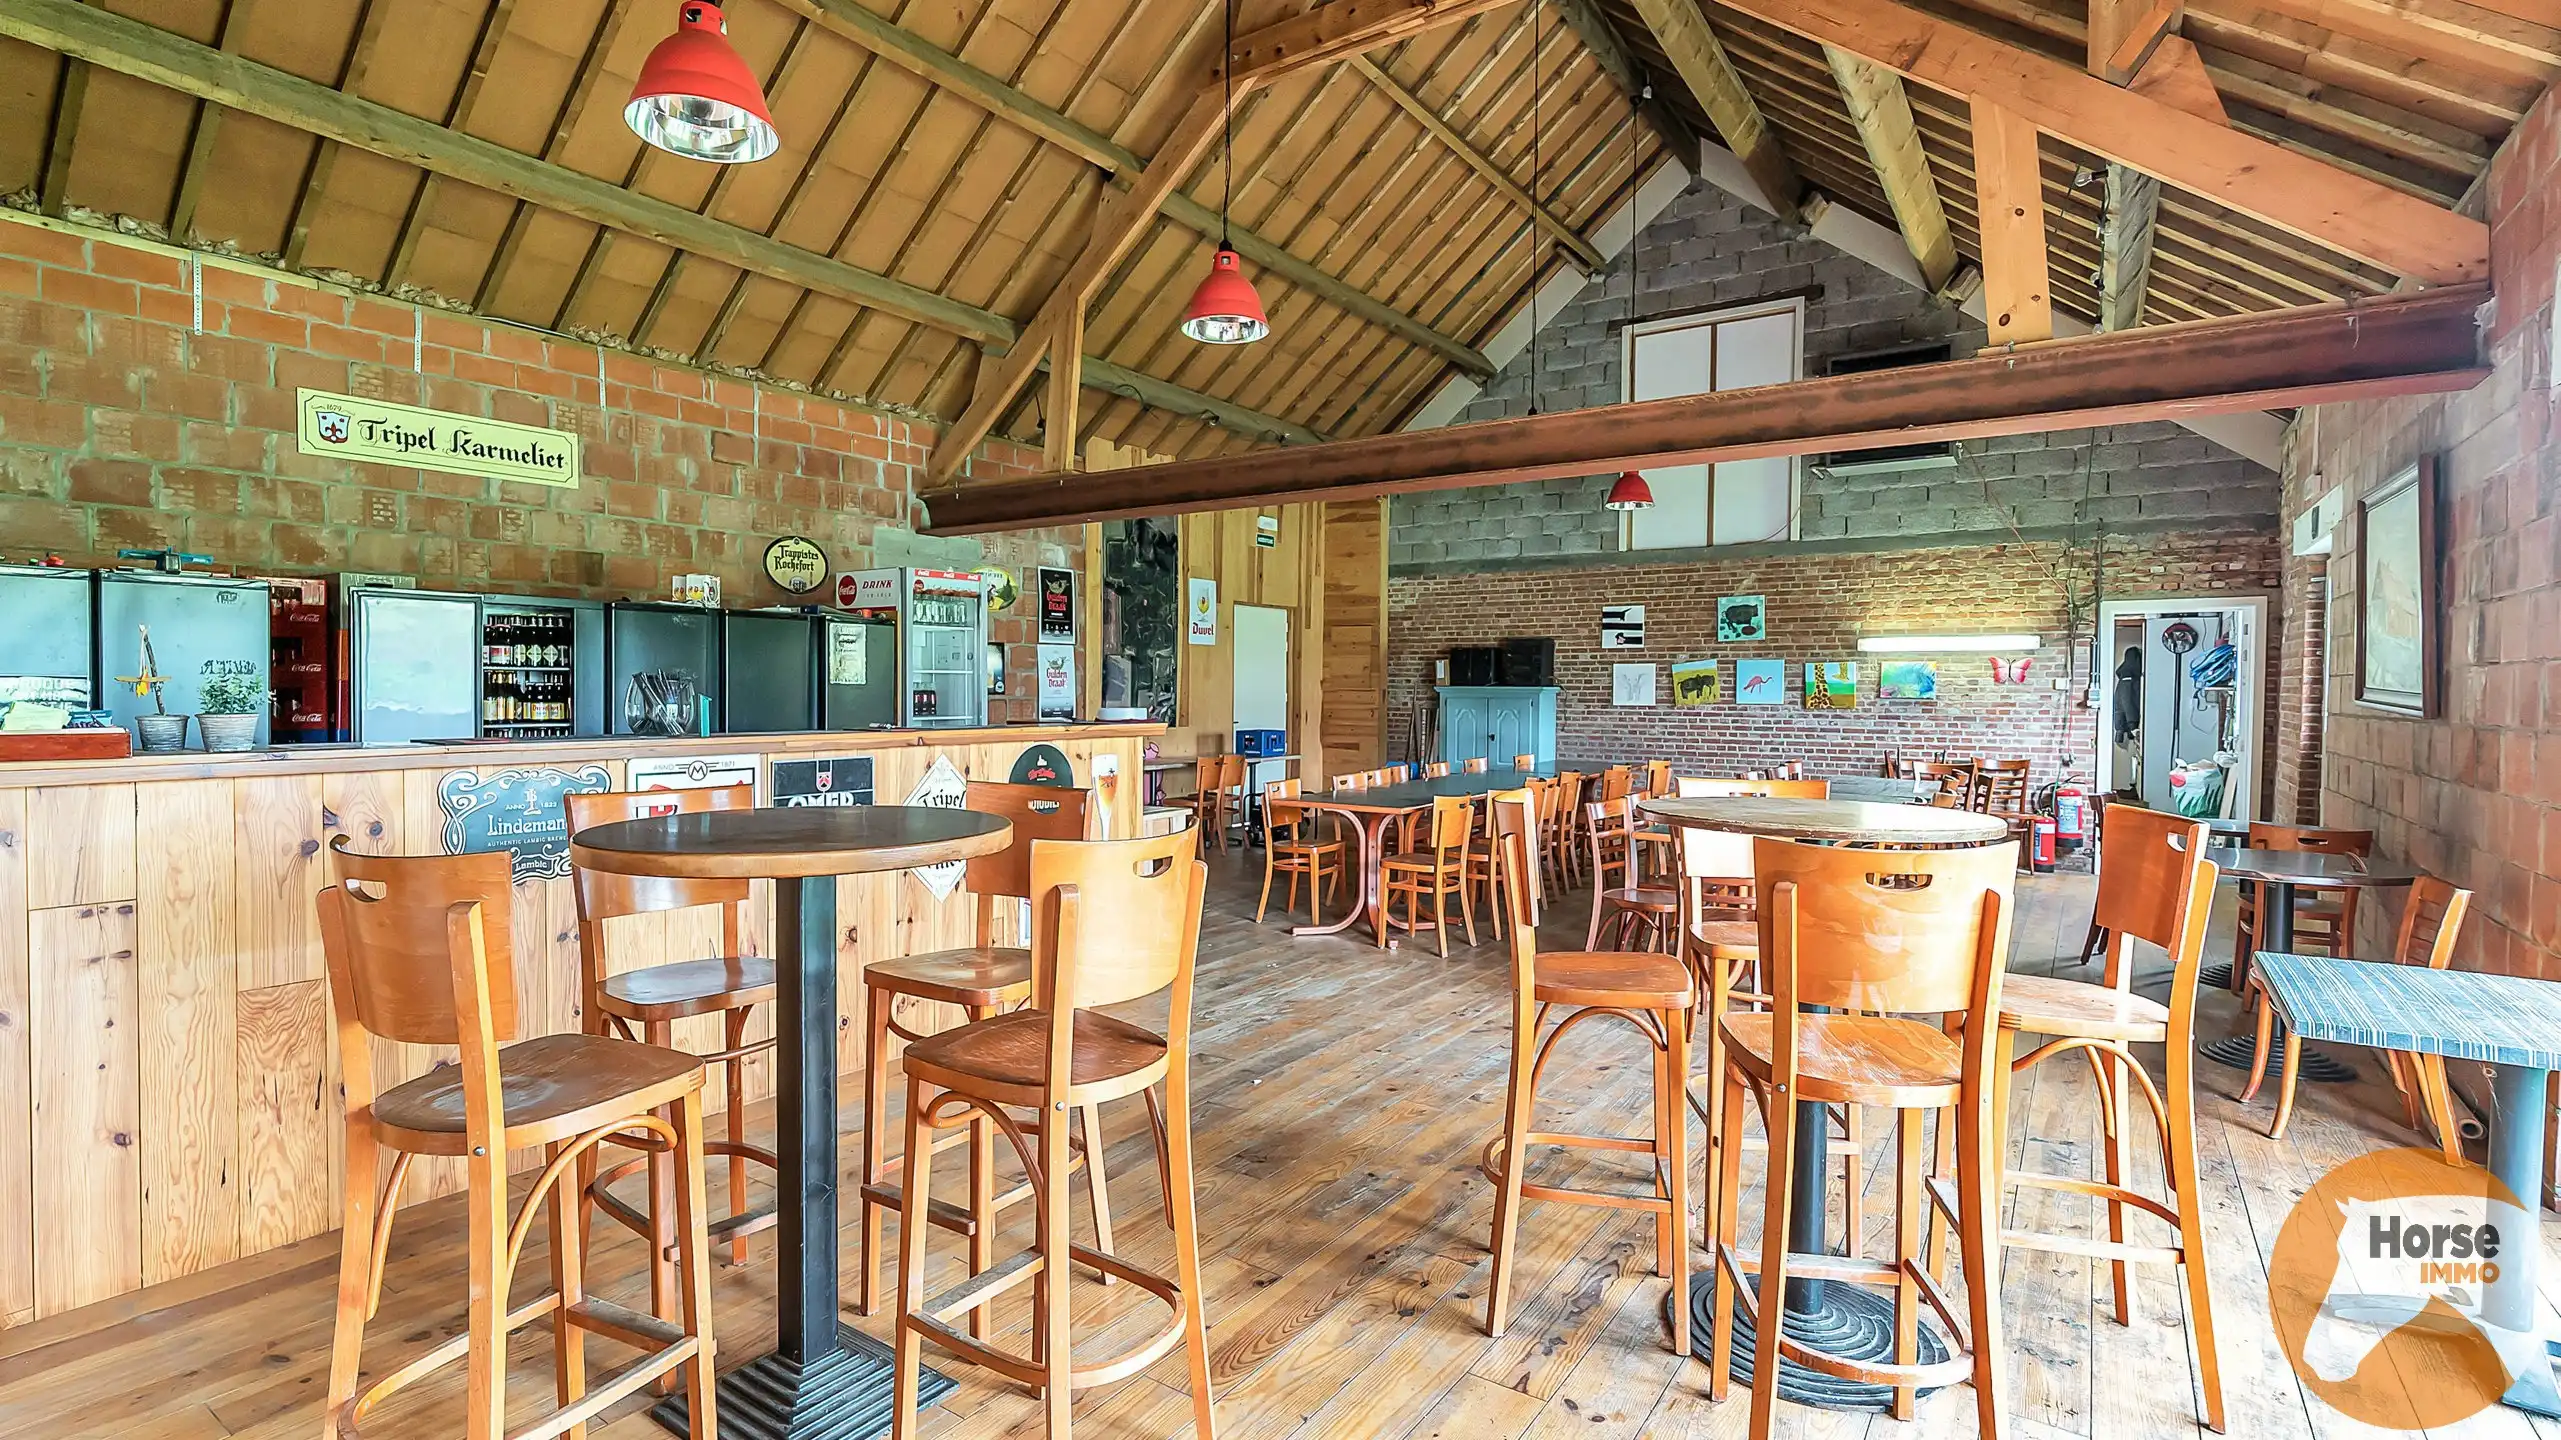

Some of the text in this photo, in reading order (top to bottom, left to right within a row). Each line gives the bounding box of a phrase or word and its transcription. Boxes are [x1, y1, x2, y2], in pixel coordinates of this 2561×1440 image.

[357, 416, 565, 469] Tripel Karmeliet
[778, 545, 819, 560] Trappistes
[774, 556, 814, 573] Rochefort
[862, 580, 892, 590] DRINK
[1192, 622, 1214, 635] Duvel
[487, 814, 568, 836] Lindeman
[487, 839, 522, 847] AUTHENTIC
[515, 860, 547, 871] Lambic
